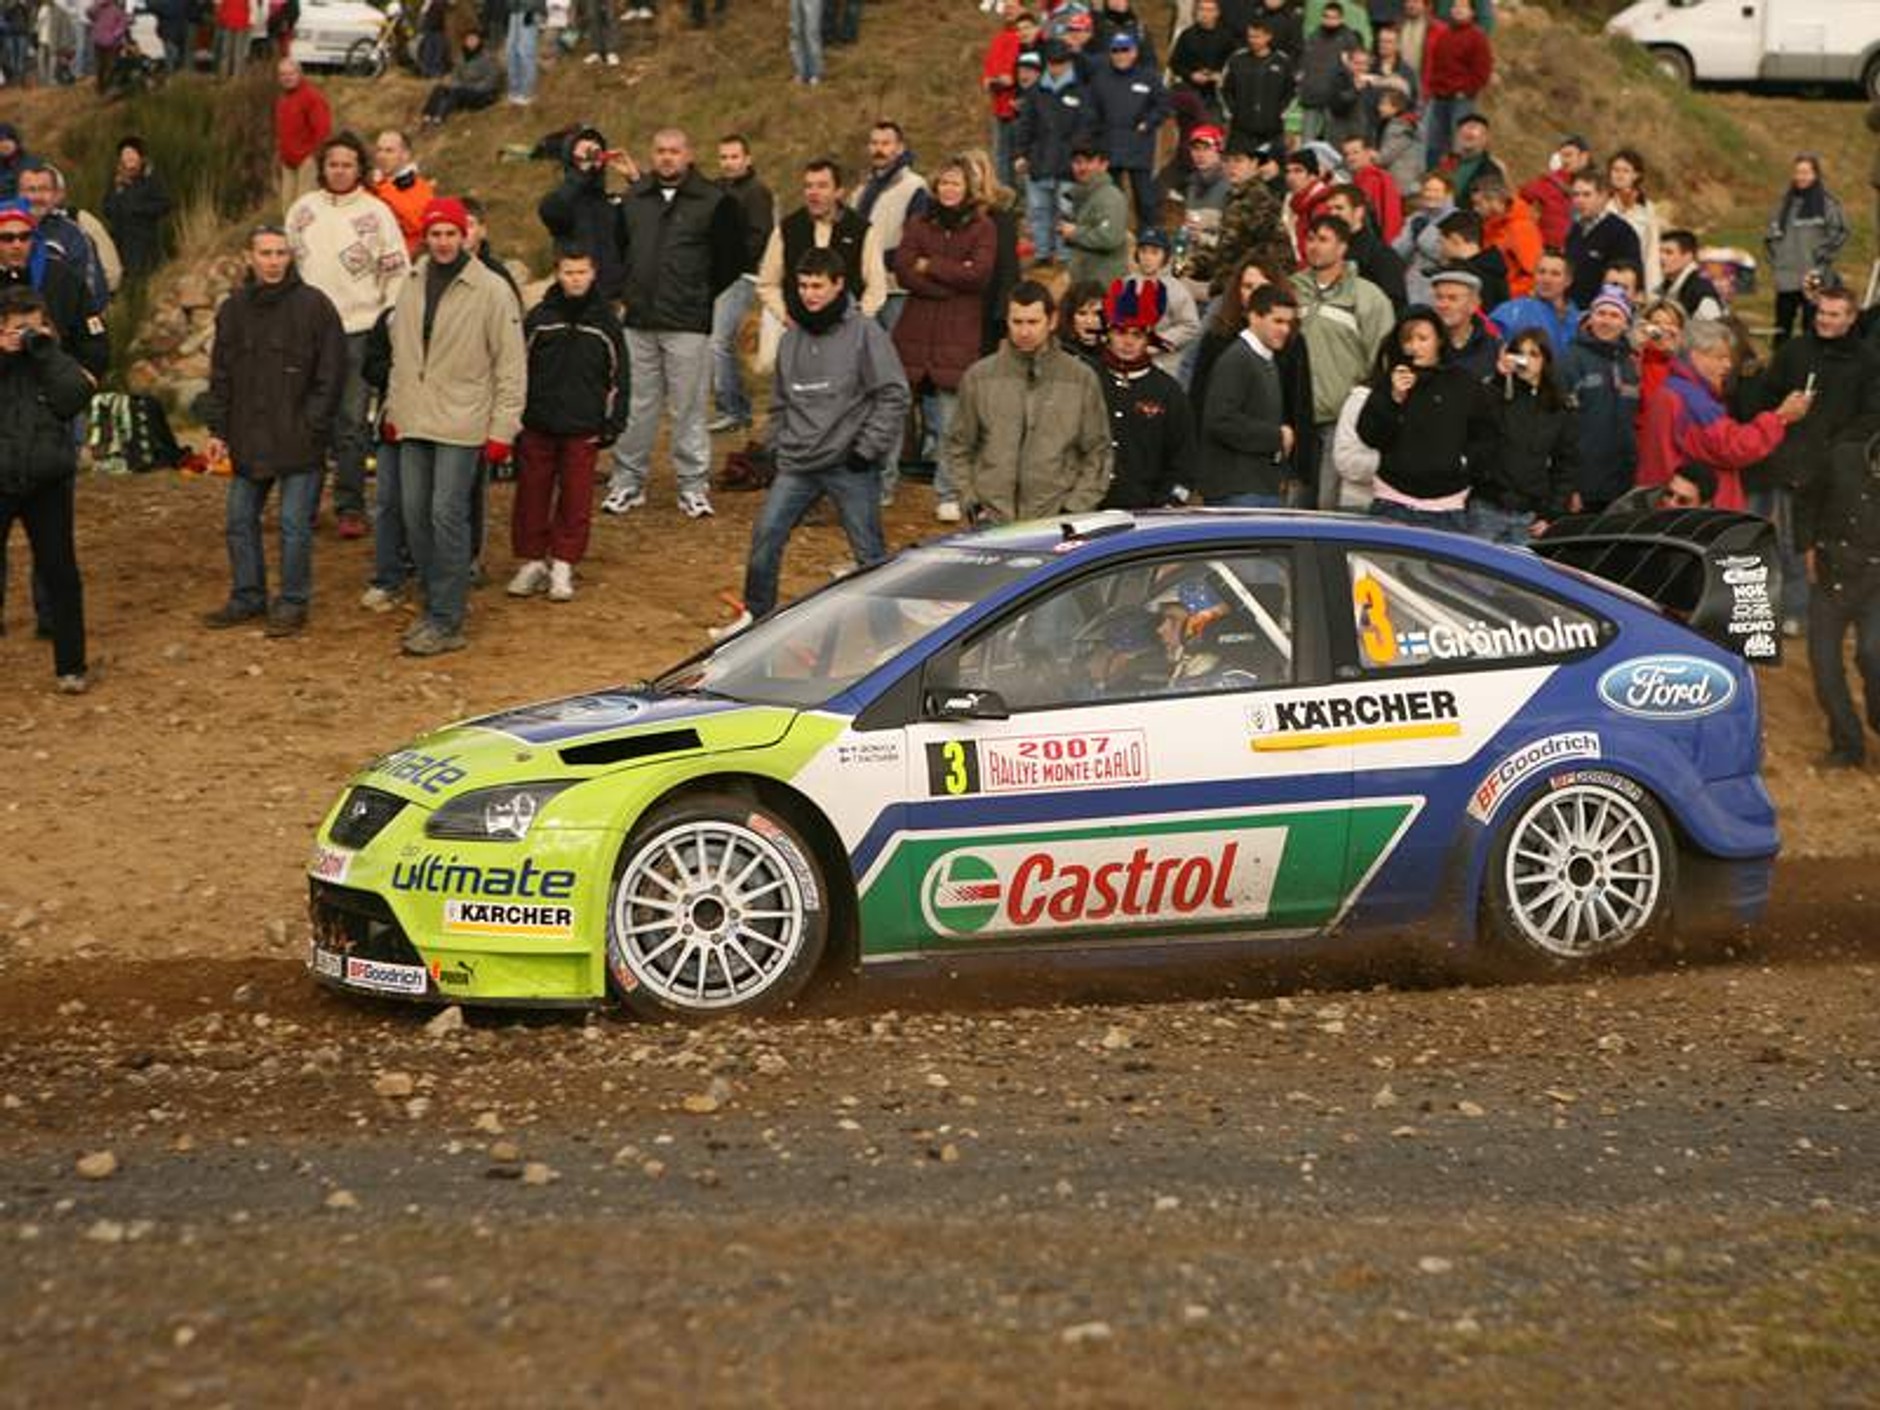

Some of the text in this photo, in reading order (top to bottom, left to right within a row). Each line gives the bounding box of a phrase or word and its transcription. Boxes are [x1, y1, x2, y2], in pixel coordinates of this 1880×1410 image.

[1353, 571, 1398, 665] 3
[1429, 616, 1598, 659] Grönholm
[1627, 664, 1712, 706] Ford
[1275, 690, 1458, 731] KÄRCHER
[943, 740, 968, 795] 3
[989, 751, 1038, 786] RALLYE
[1018, 737, 1110, 760] 2007
[1476, 735, 1598, 812] BFGoodrich
[391, 853, 576, 898] ultimate
[1007, 841, 1239, 925] Castrol
[461, 903, 572, 926] KÄRCHER
[349, 961, 422, 986] BFGoodrich
